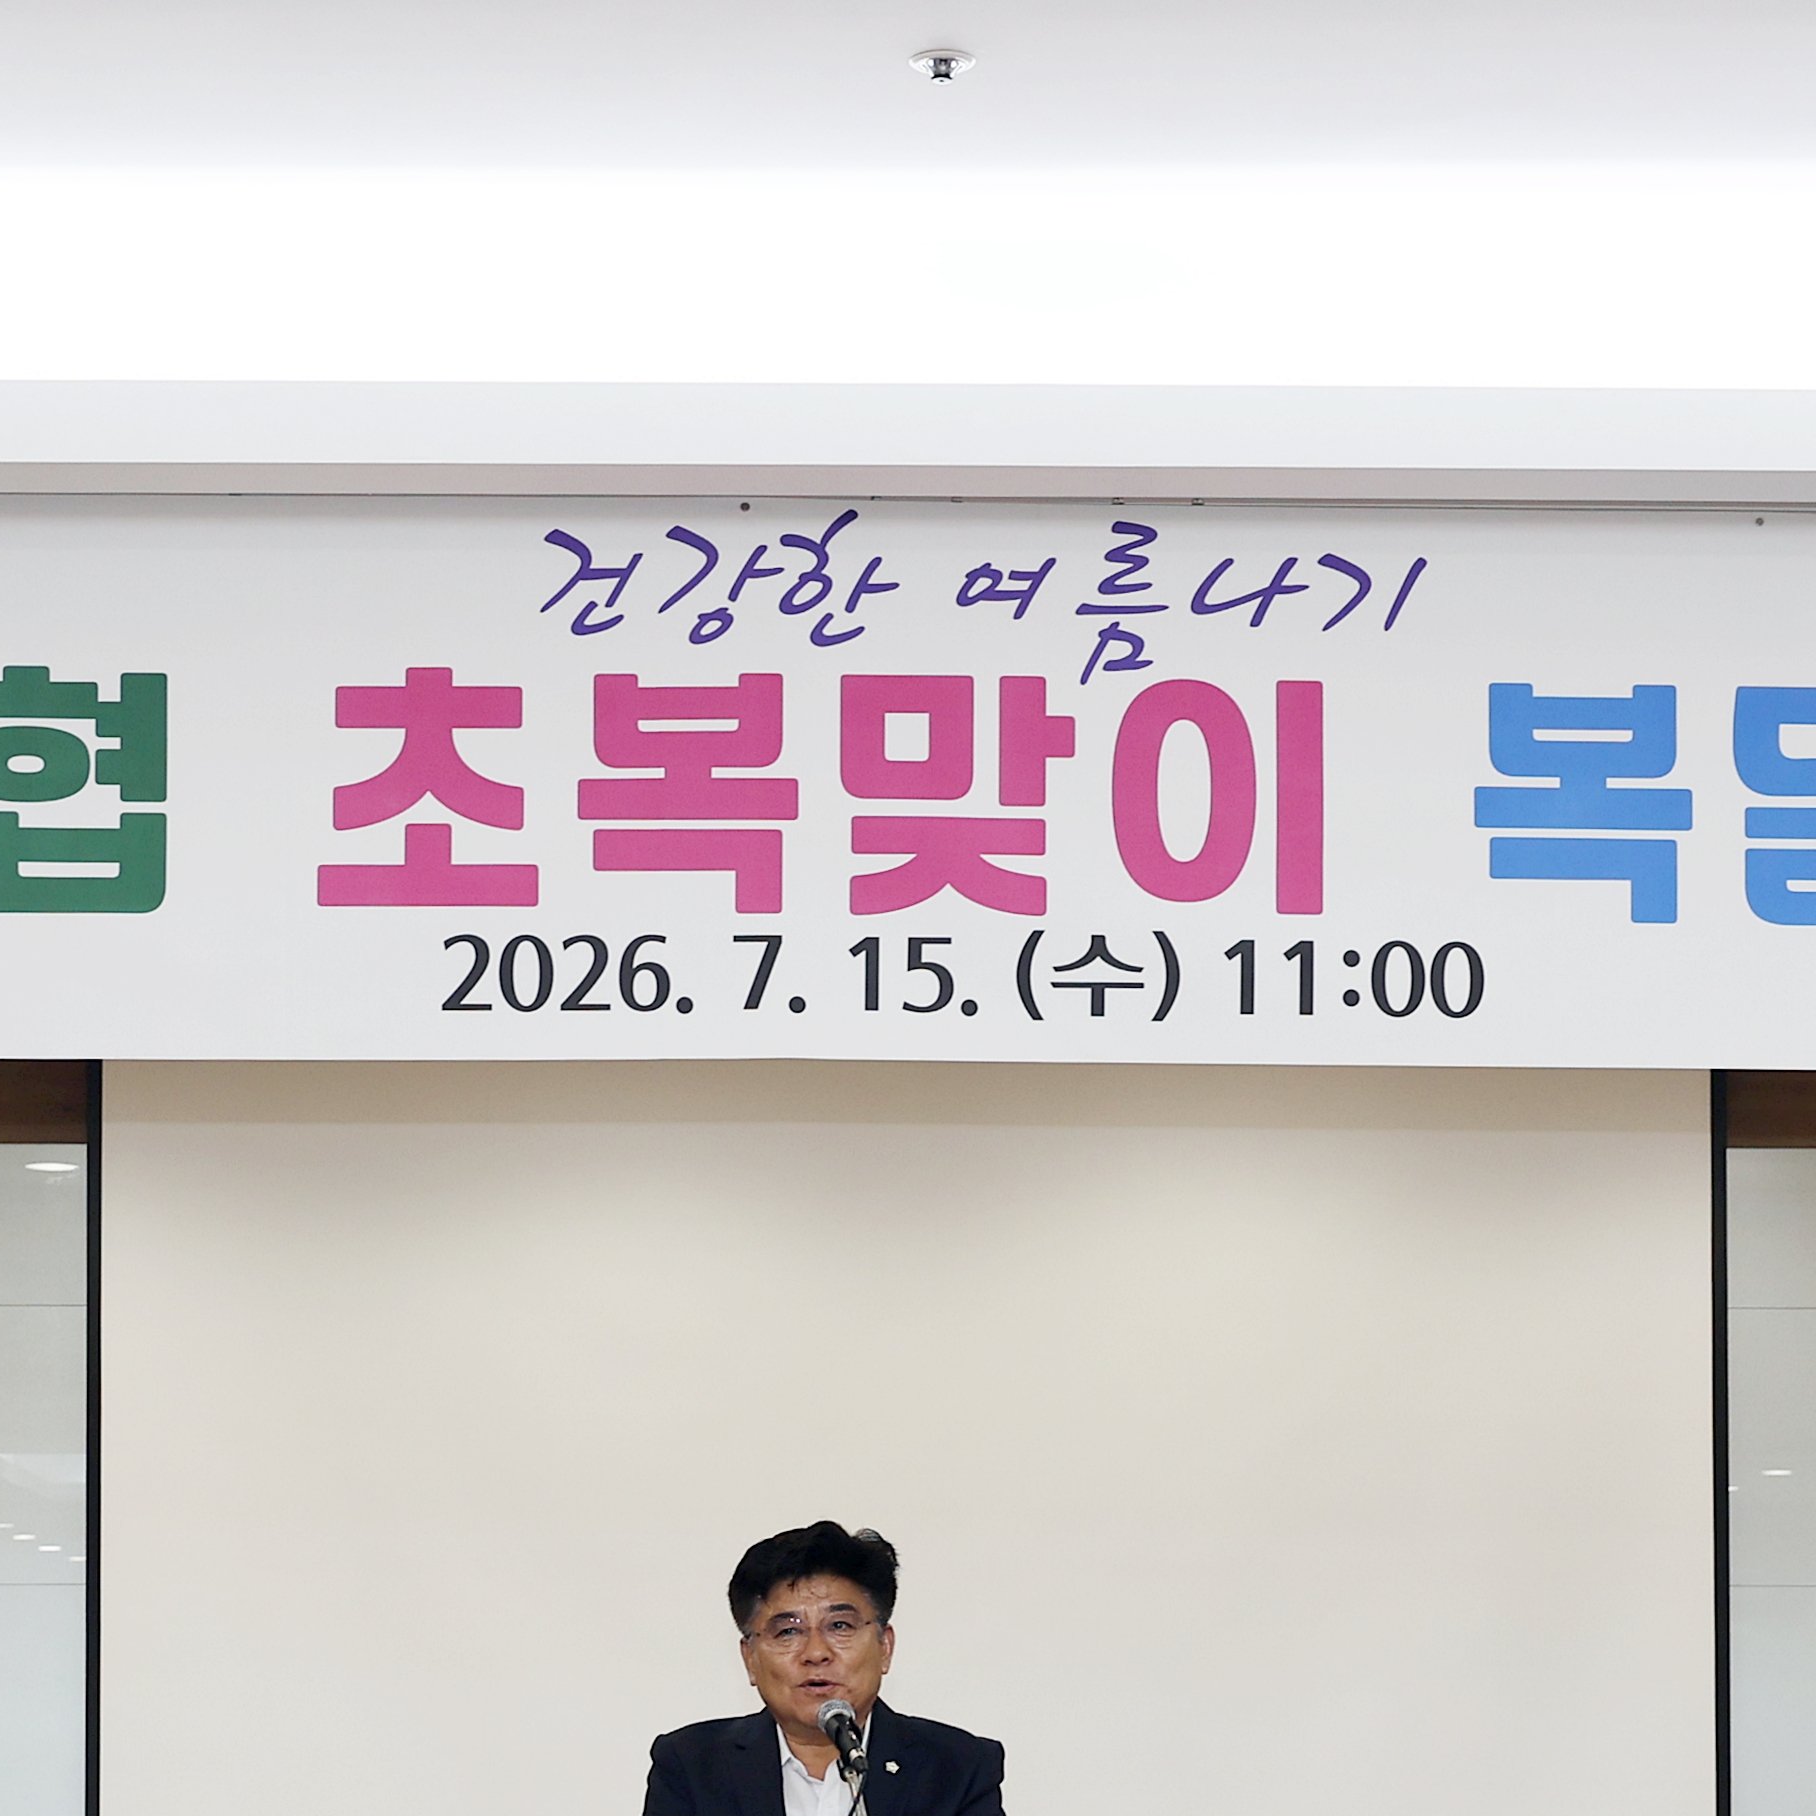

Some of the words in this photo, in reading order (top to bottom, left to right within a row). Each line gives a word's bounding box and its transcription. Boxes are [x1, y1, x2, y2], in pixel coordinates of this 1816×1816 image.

[540, 508, 900, 647] 건강한
[957, 520, 1427, 686] 여름나기
[317, 667, 1324, 917] 초복맞이
[441, 934, 694, 1014] 2026.
[732, 934, 807, 1014] 7.
[848, 936, 979, 1017] 15.
[1016, 929, 1181, 1021] (수)
[1224, 939, 1485, 1019] 11:00
